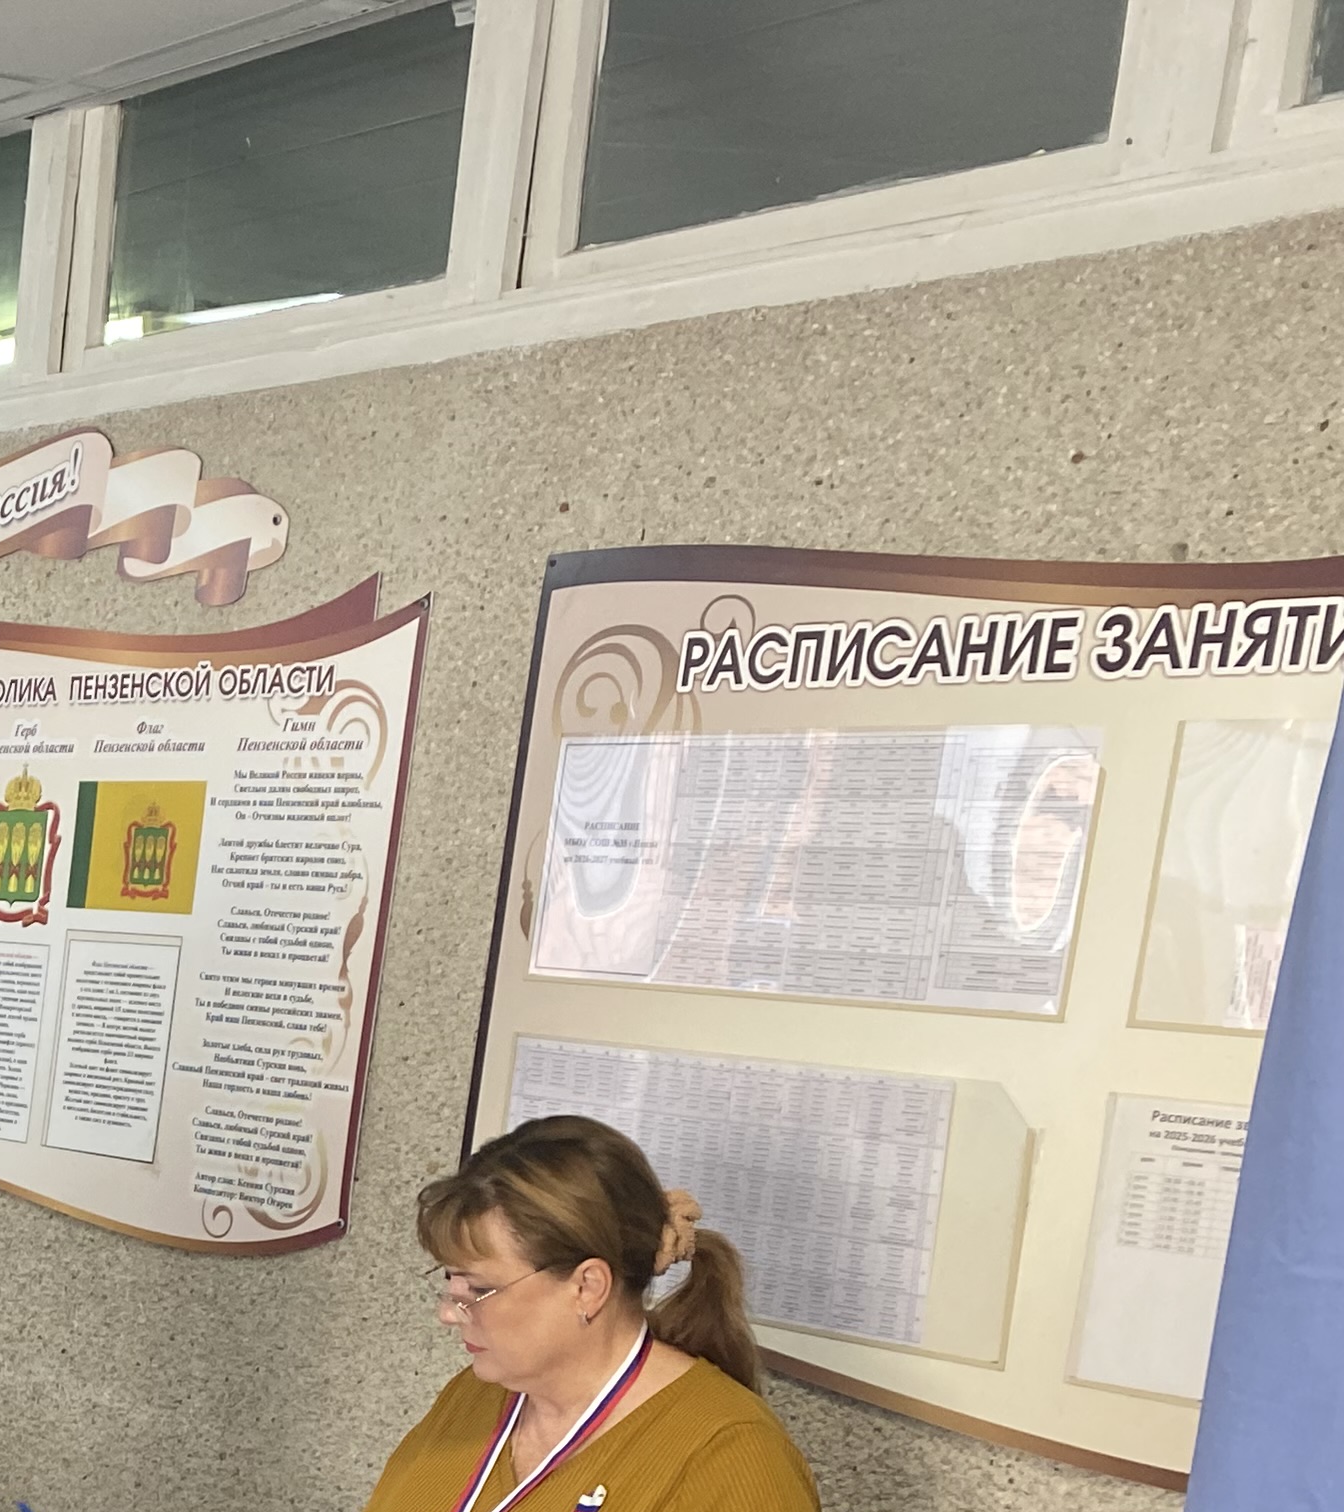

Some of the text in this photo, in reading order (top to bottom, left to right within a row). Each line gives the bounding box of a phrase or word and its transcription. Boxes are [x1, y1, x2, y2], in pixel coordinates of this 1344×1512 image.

[680, 604, 1344, 687] РАСПИСАНИЕ ЗАНЯТИ
[69, 665, 211, 701] ПЕНЗЕНСКОЙ
[220, 665, 337, 695] ОБЛАСТИ
[15, 724, 37, 739] Герб
[137, 720, 163, 736] Флаг
[283, 717, 315, 733] Гимн
[33, 740, 75, 755] области
[94, 738, 205, 754] Пензенской области
[237, 735, 364, 753] Пензенской области
[1151, 1110, 1232, 1130] Расписание
